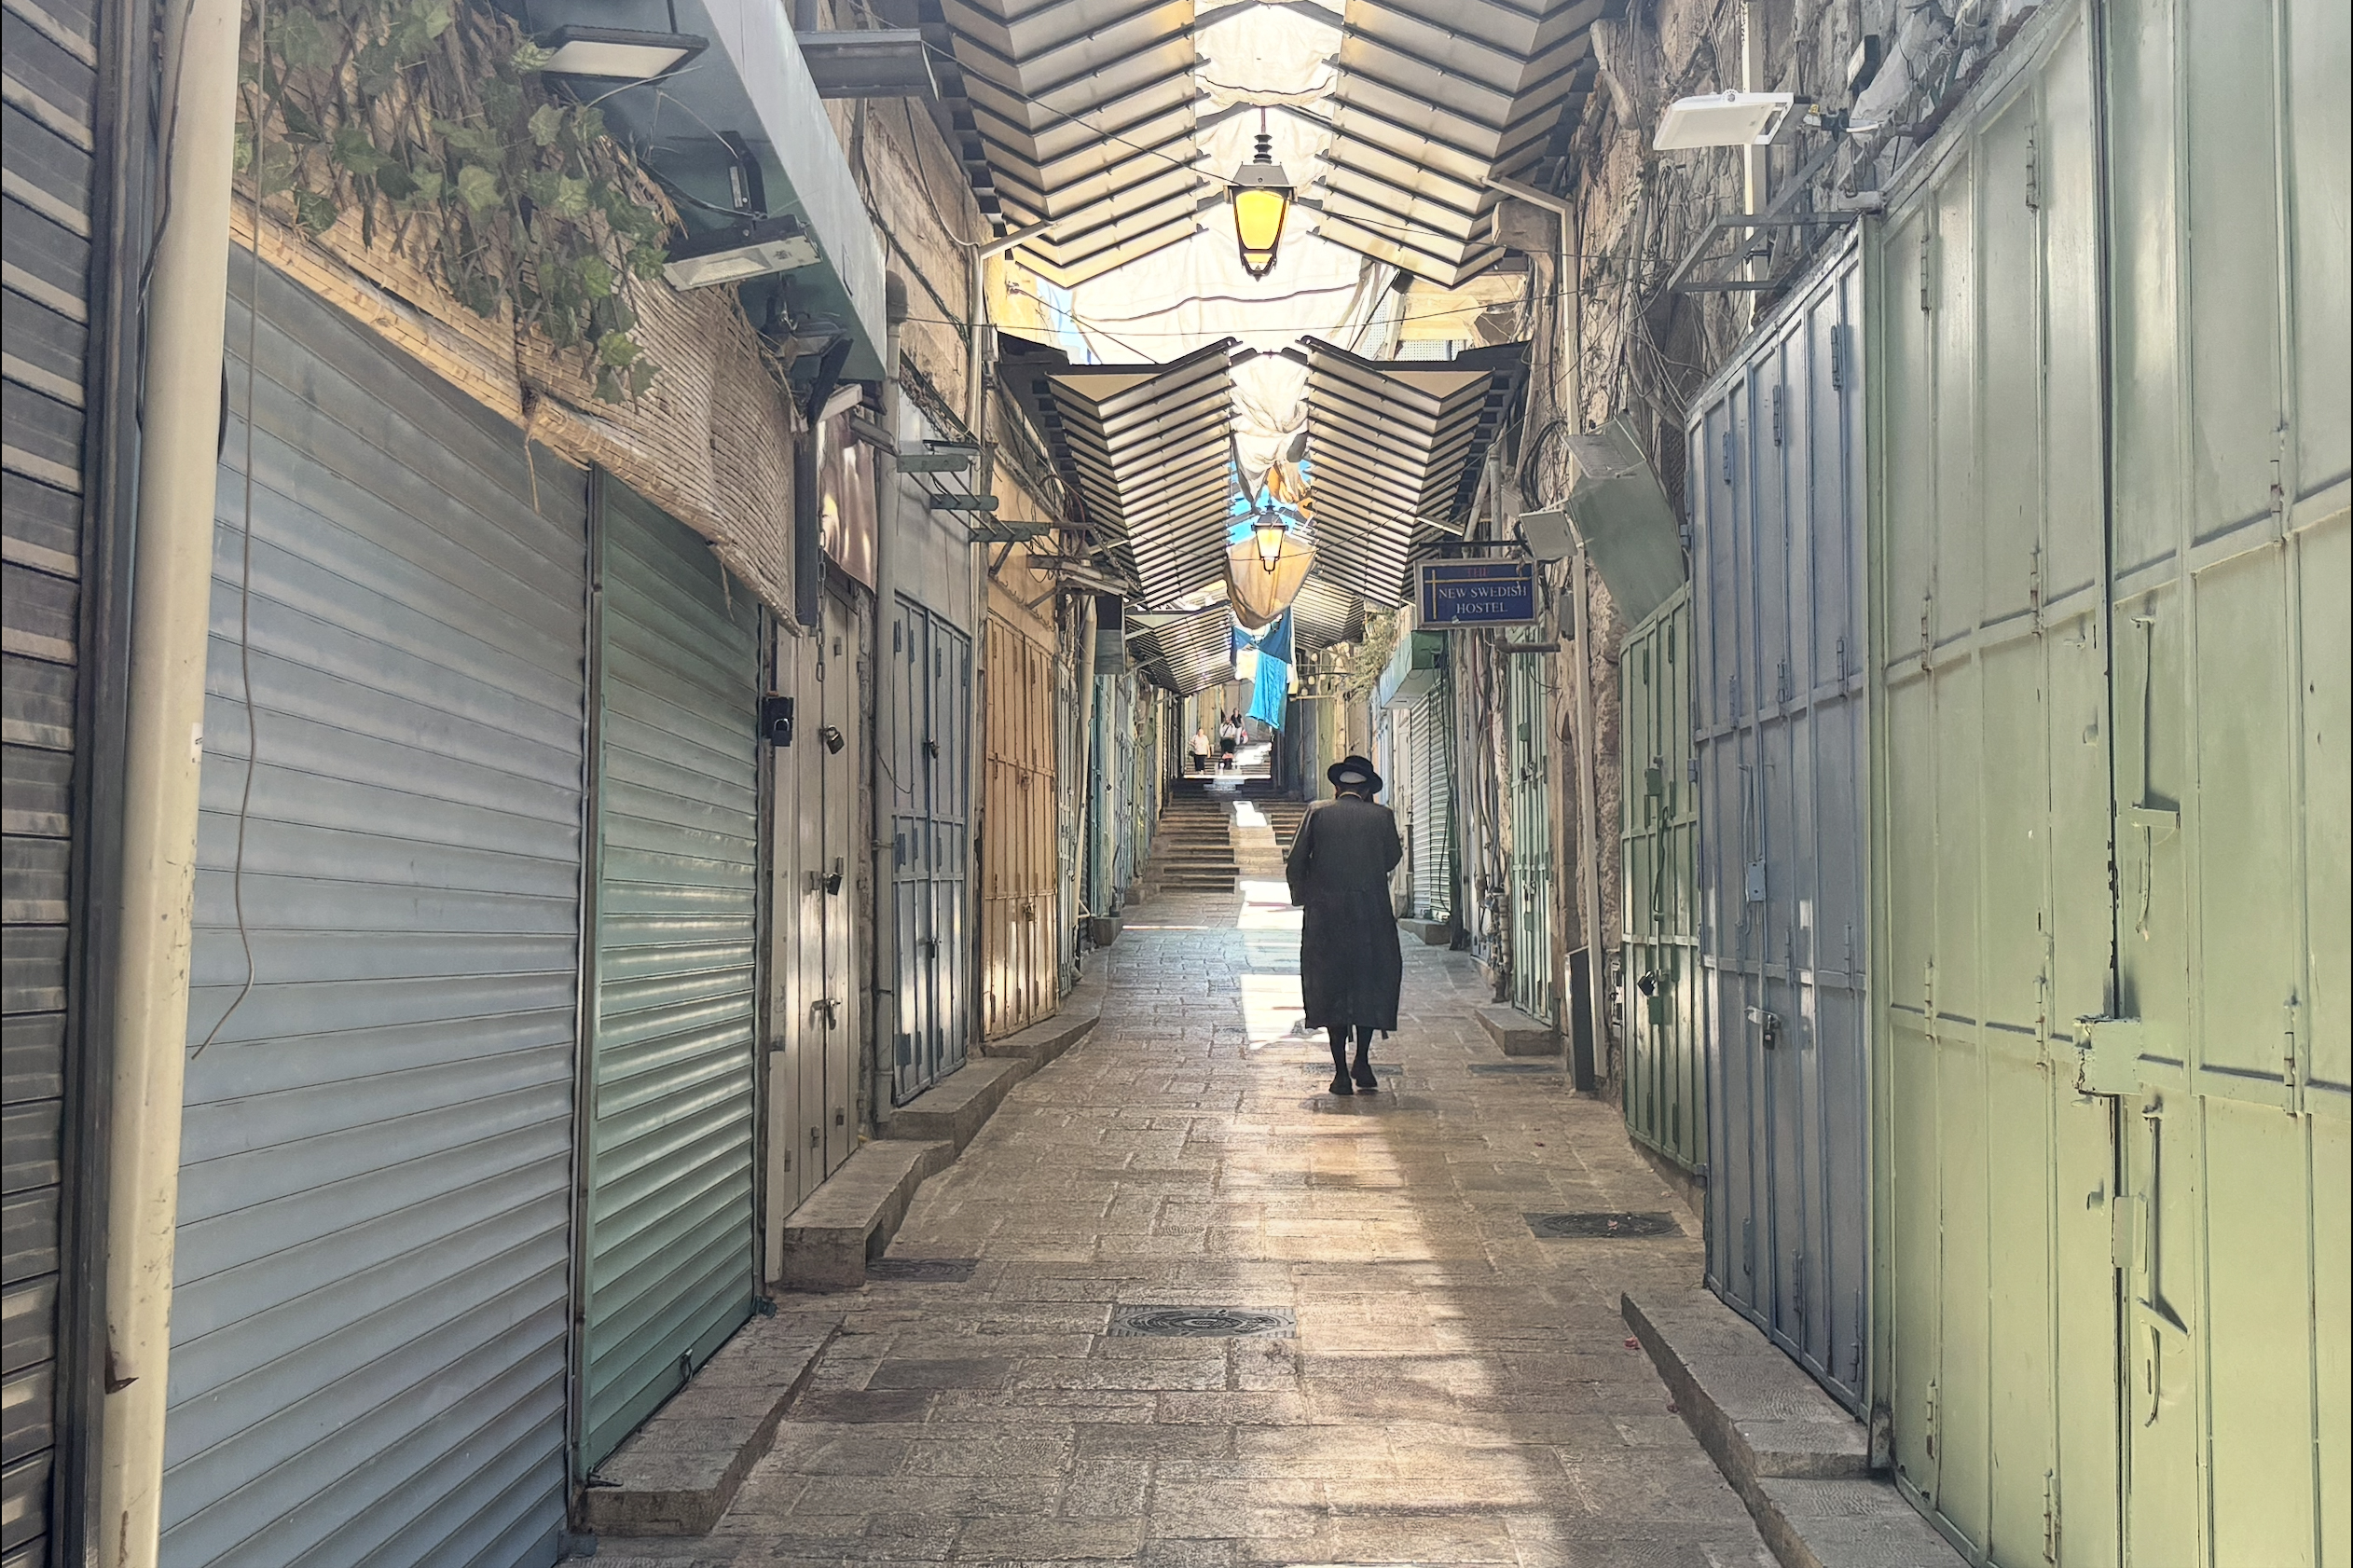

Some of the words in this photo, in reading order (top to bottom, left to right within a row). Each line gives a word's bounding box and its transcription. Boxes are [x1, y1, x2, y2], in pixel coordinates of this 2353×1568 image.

[1438, 587, 1466, 598] NEW
[1470, 585, 1527, 598] SWEDISH
[1456, 602, 1507, 614] HOSTEL
